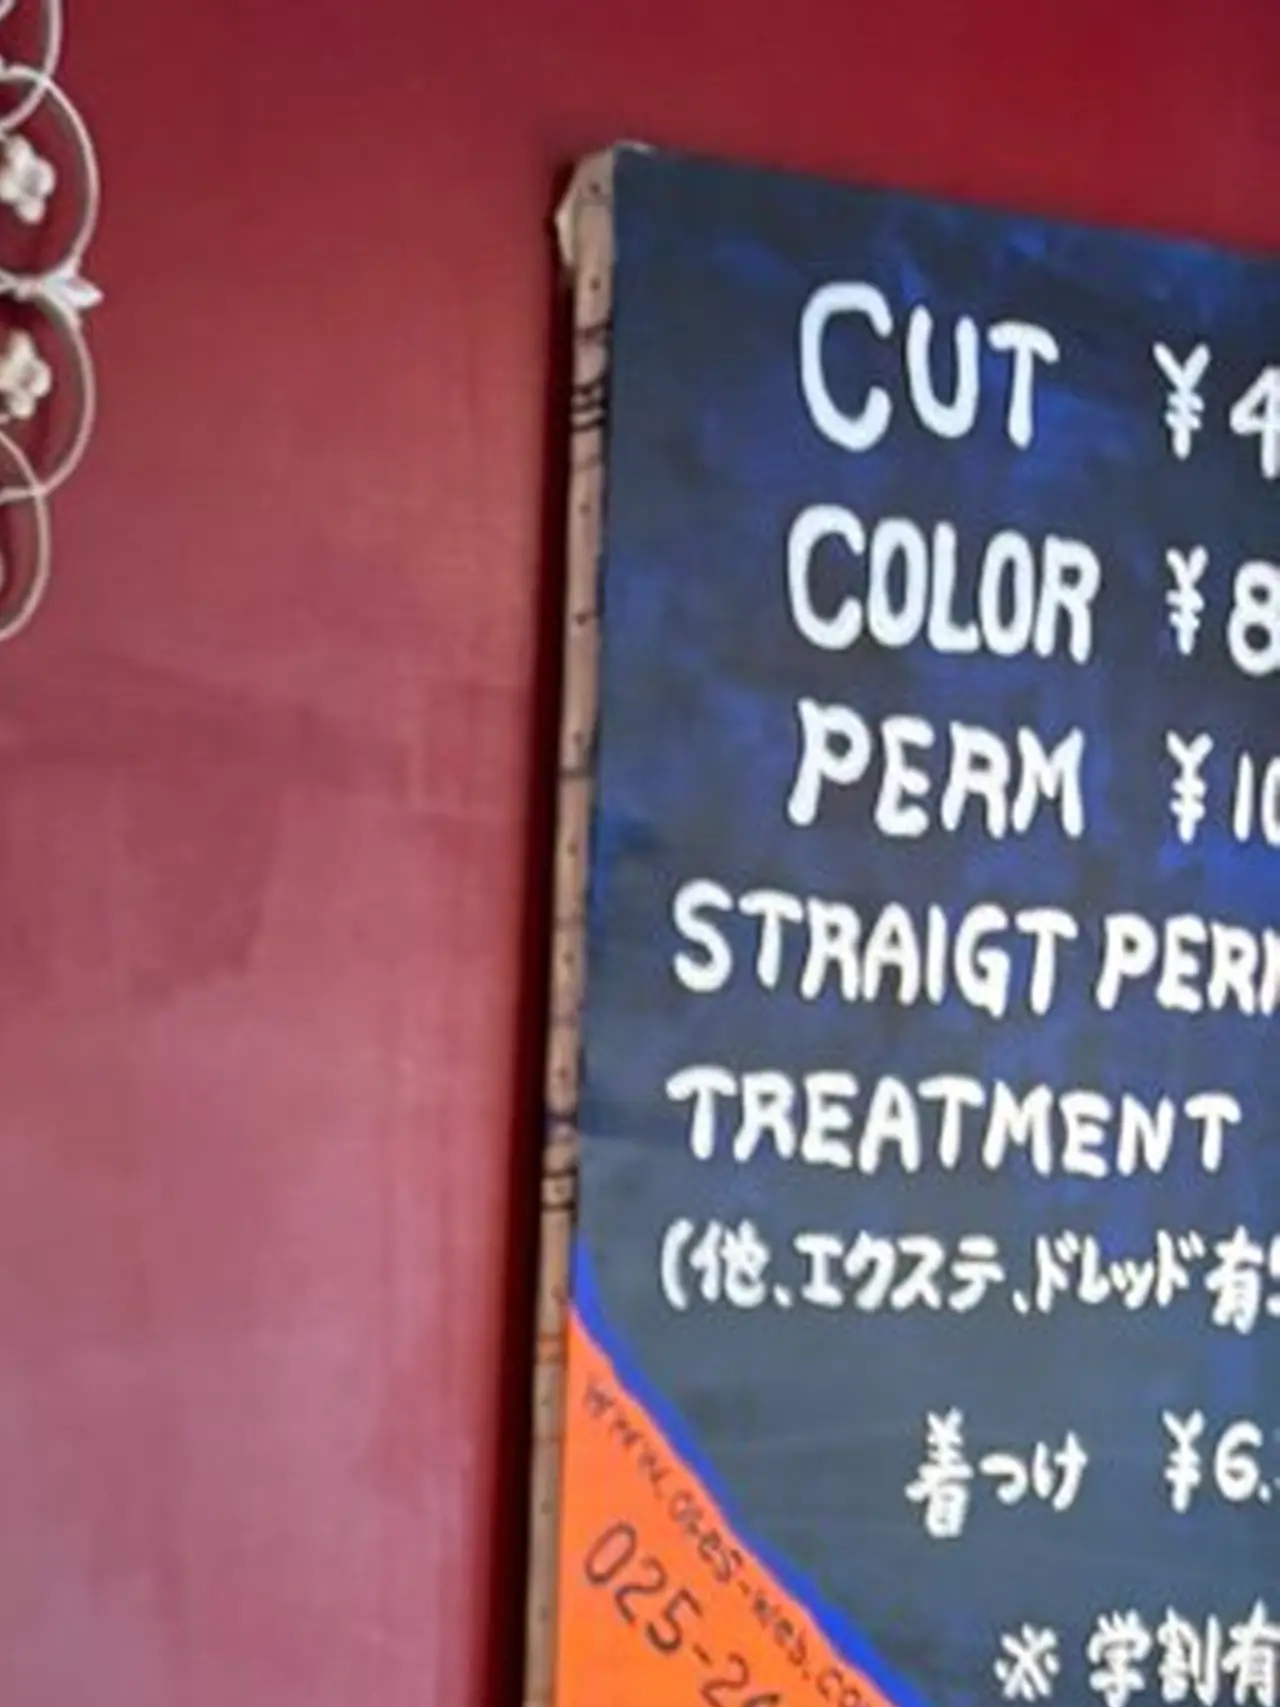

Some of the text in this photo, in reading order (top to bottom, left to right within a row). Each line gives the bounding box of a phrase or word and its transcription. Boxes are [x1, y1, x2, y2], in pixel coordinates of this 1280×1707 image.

[801, 284, 1059, 451] CUT
[787, 504, 1101, 664] COLOR
[787, 698, 1085, 839] PERM
[673, 879, 1079, 1019] STRAIGT
[665, 1065, 1242, 1179] TREATMENT
